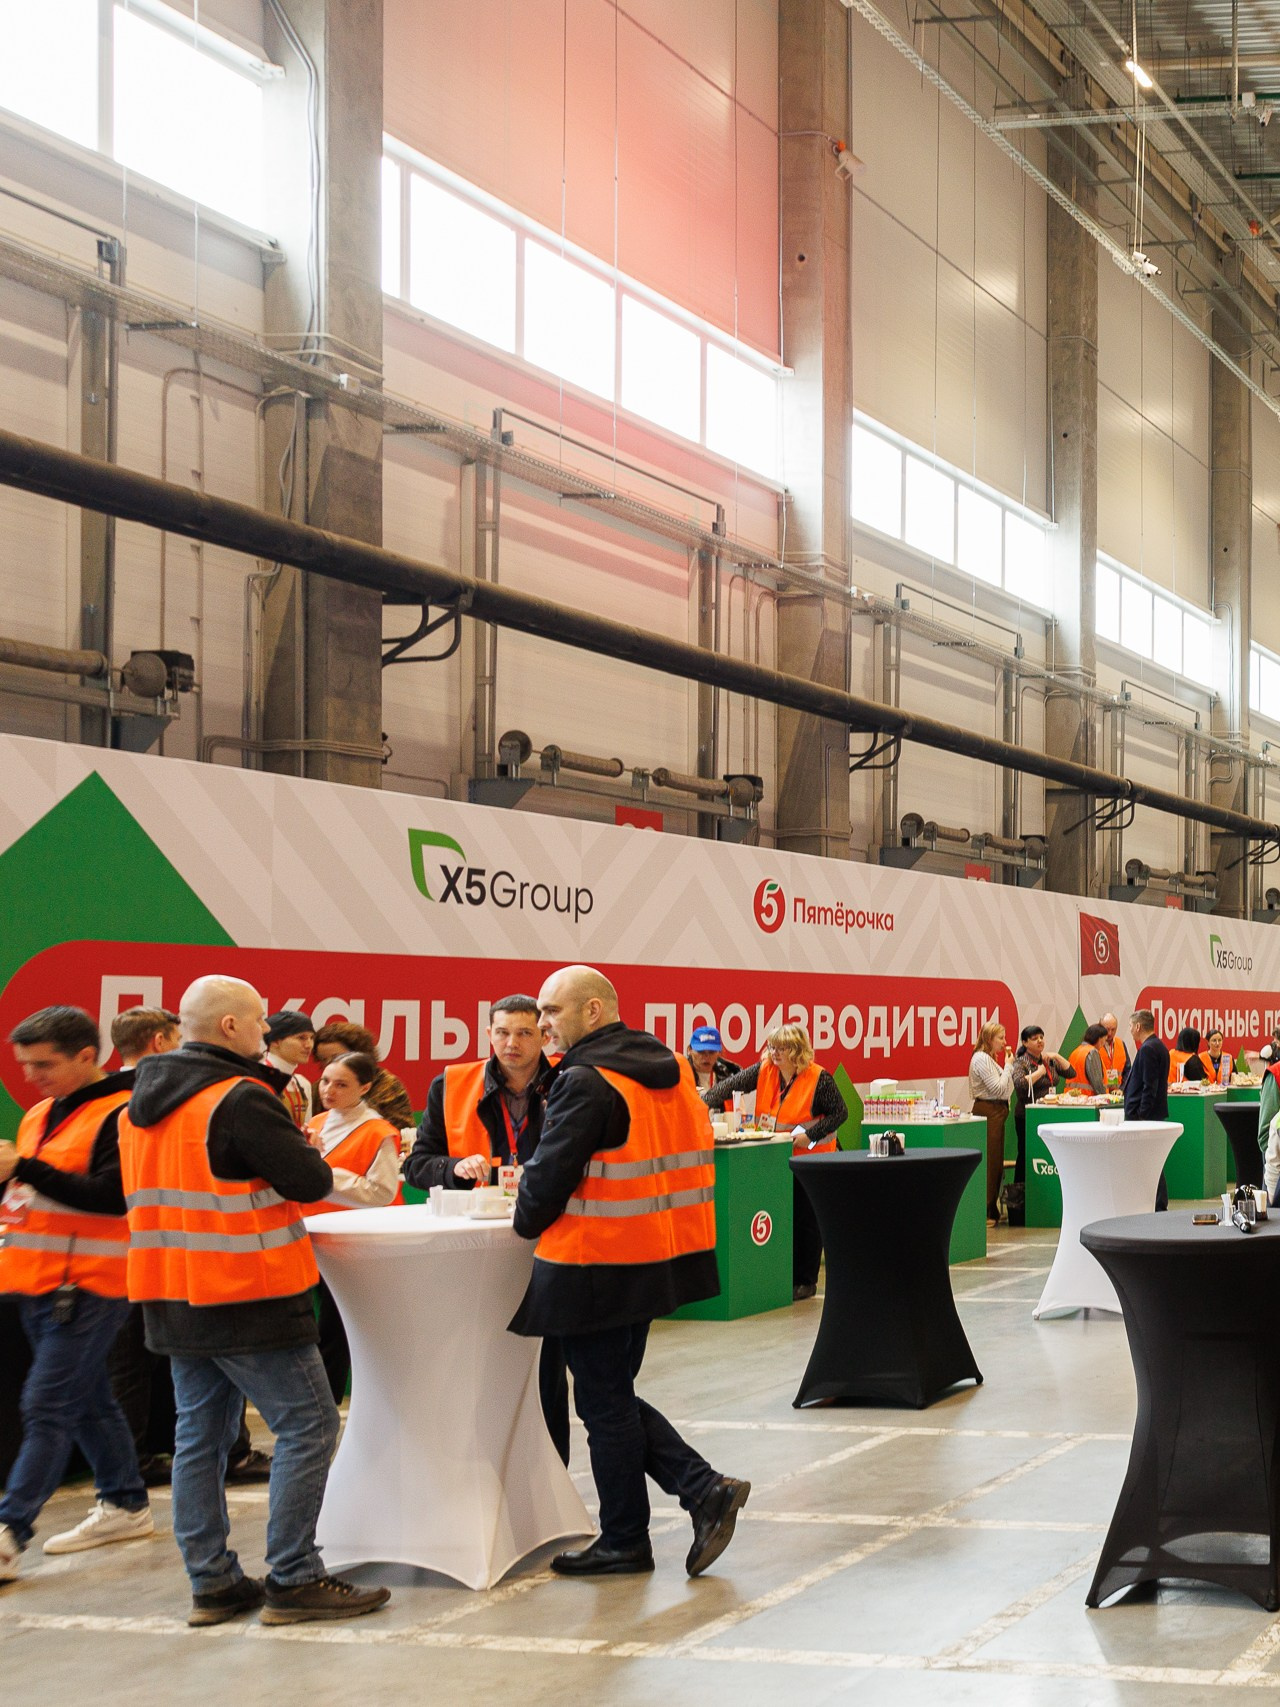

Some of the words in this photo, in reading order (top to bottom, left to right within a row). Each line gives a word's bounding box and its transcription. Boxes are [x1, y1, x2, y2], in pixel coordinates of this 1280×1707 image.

[438, 864, 594, 923] X5Group
[757, 879, 783, 930] 5
[794, 897, 894, 934] Пятёрочка
[1216, 949, 1253, 975] X5Group
[1151, 1000, 1260, 1040] Локальные
